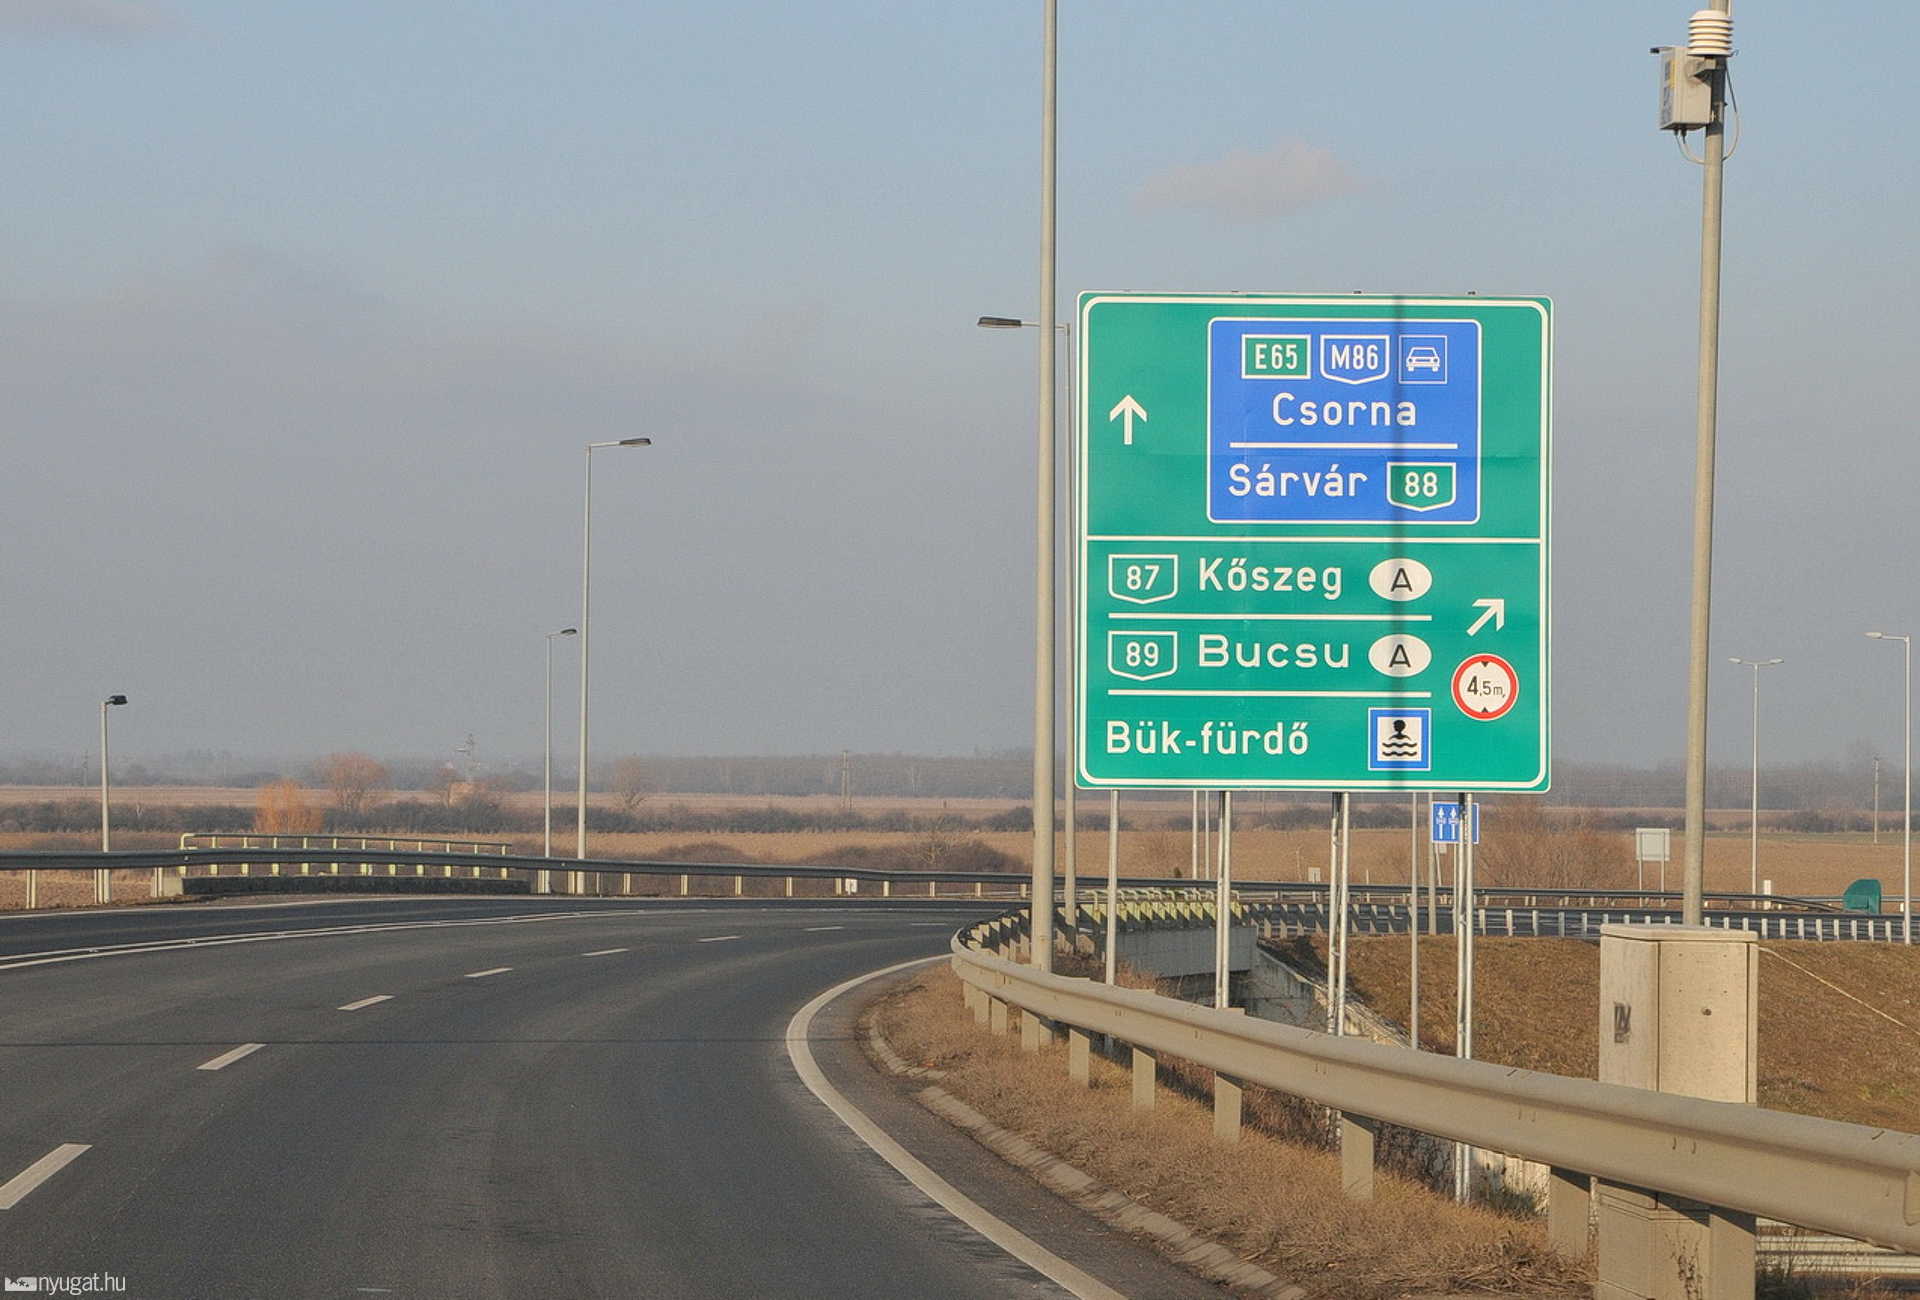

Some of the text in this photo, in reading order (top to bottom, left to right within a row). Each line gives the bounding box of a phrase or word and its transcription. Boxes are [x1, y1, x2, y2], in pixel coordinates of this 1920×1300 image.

[1255, 344, 1298, 370] E65
[1331, 344, 1379, 370] M86
[1272, 392, 1416, 426] Csorna
[1228, 463, 1368, 497] Sárvár
[1404, 471, 1438, 497] 88
[1126, 557, 1342, 600] 87 Kőszeg
[1390, 567, 1413, 593] A
[1126, 633, 1349, 668] 89 Bucsu
[1389, 643, 1412, 669] A
[1106, 720, 1309, 755] Bük-fürdő
